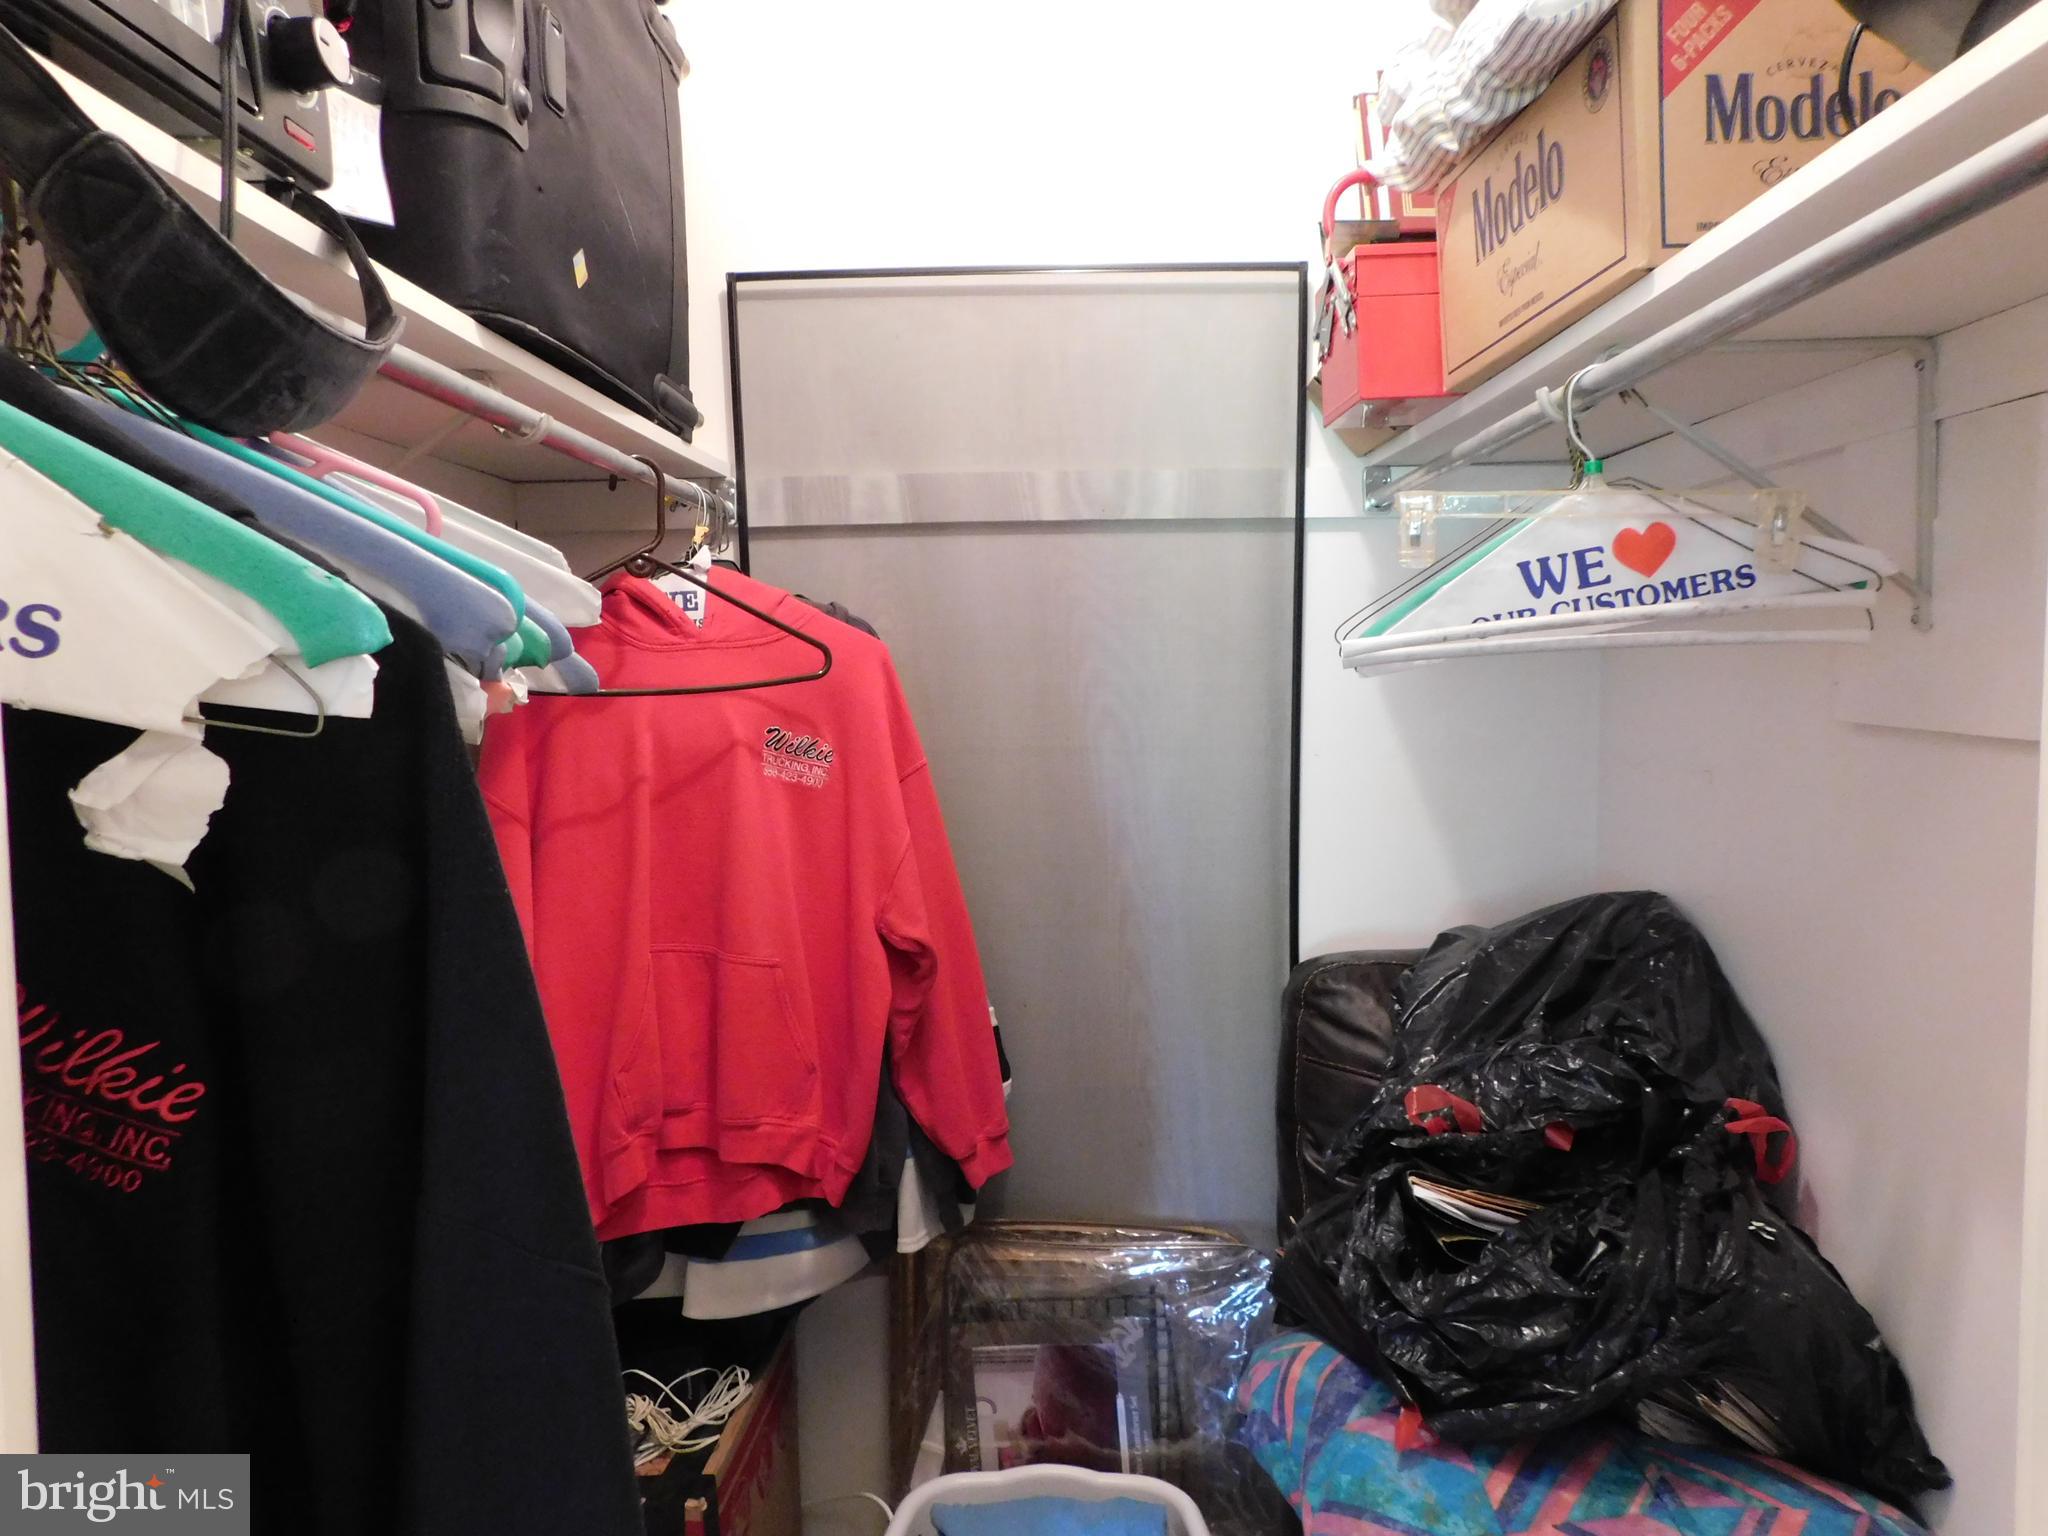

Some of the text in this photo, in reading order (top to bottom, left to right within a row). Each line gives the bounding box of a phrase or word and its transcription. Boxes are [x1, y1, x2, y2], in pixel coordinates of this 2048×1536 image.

[1666, 1, 1708, 46] FOUR
[1670, 5, 1734, 72] 6-PACKS
[1472, 128, 1565, 267] Modelo
[1516, 546, 1612, 599] WE
[764, 726, 833, 763] Wilkie
